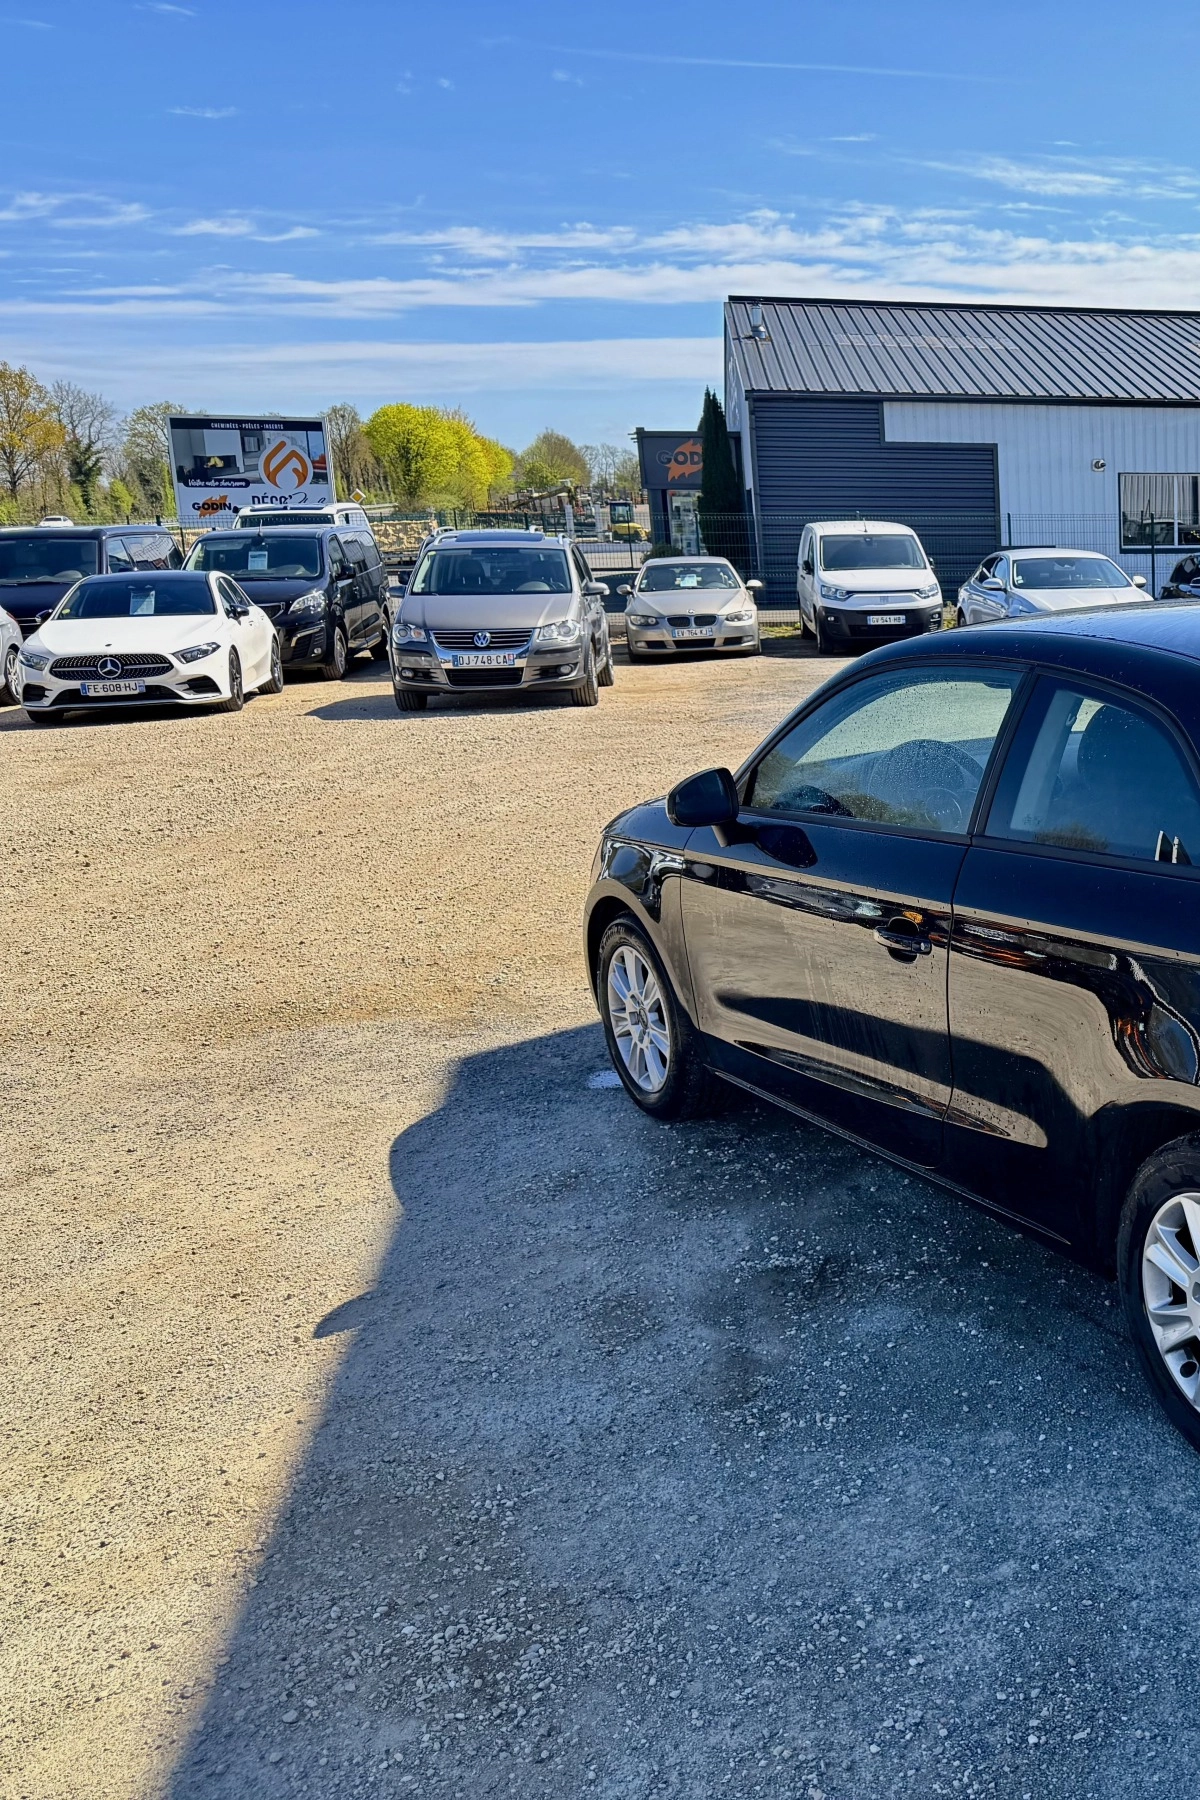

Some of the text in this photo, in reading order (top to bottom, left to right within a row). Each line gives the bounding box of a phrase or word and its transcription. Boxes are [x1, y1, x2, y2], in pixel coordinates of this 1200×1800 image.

[656, 450, 703, 466] GOD
[191, 502, 232, 511] GODIN
[86, 682, 138, 694] FE-608-HJ
